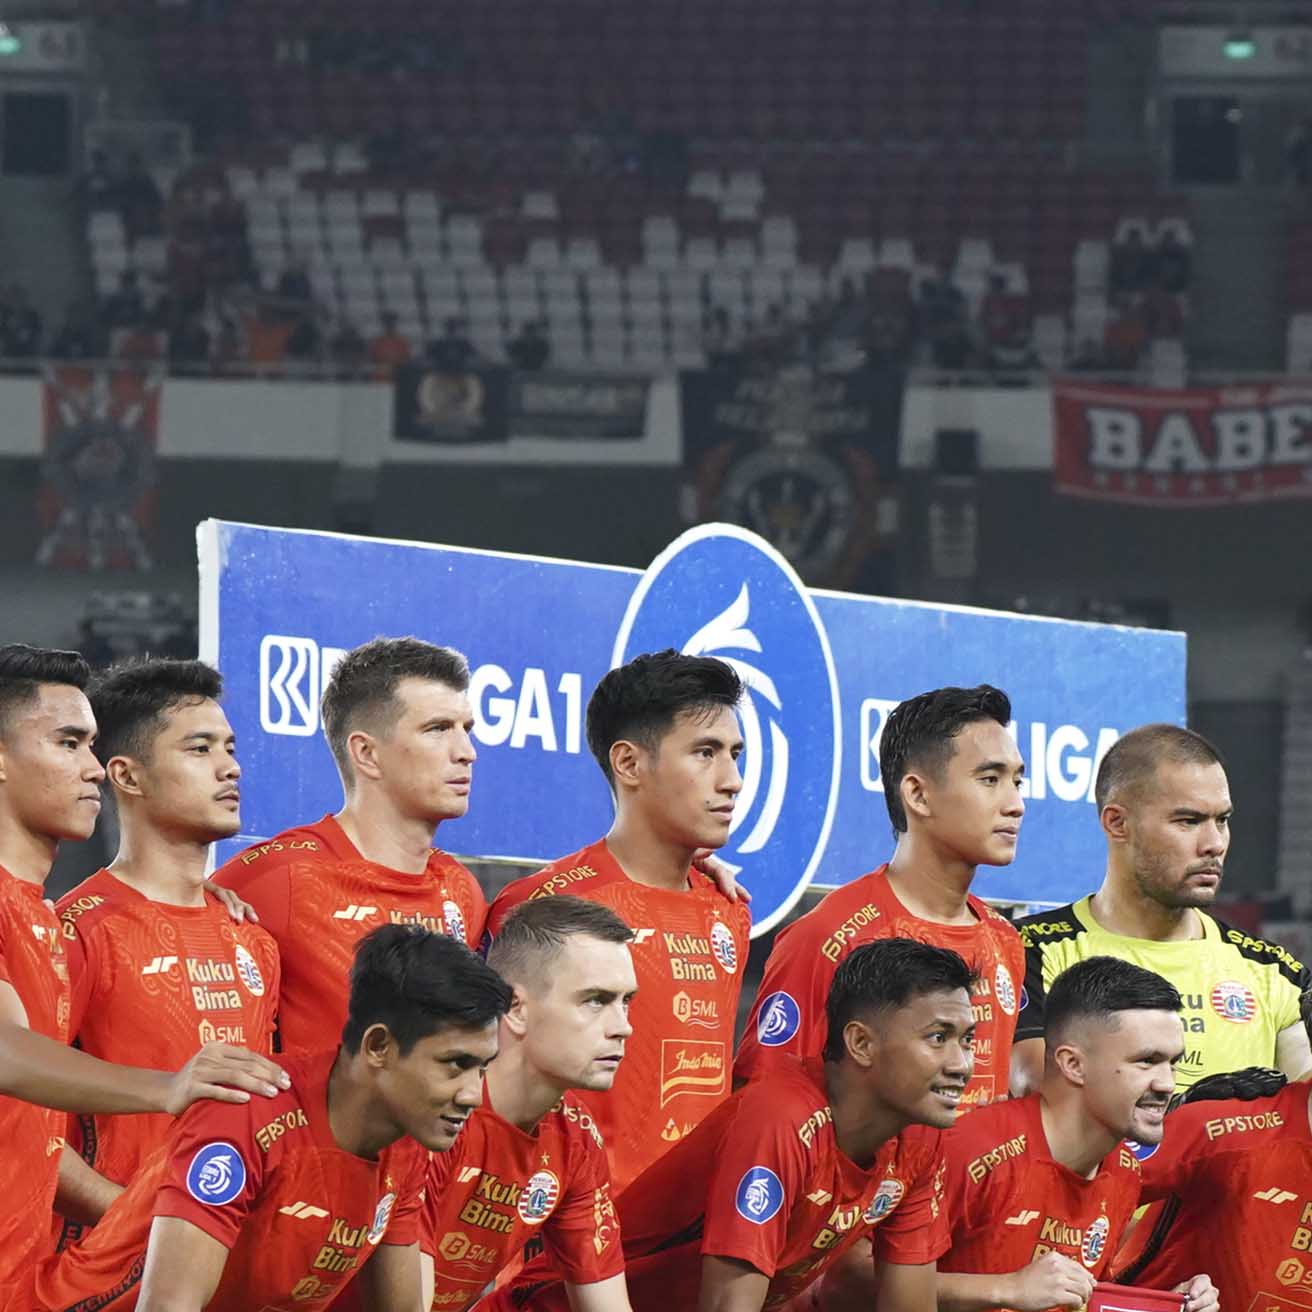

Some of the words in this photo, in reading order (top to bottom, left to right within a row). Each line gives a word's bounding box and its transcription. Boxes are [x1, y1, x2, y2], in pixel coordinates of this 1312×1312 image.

[663, 933, 710, 955] Kuku
[186, 958, 234, 983] Kuku
[671, 957, 717, 981] Bima
[192, 986, 242, 1011] Bima
[691, 999, 719, 1018] SML
[216, 1025, 247, 1044] SML
